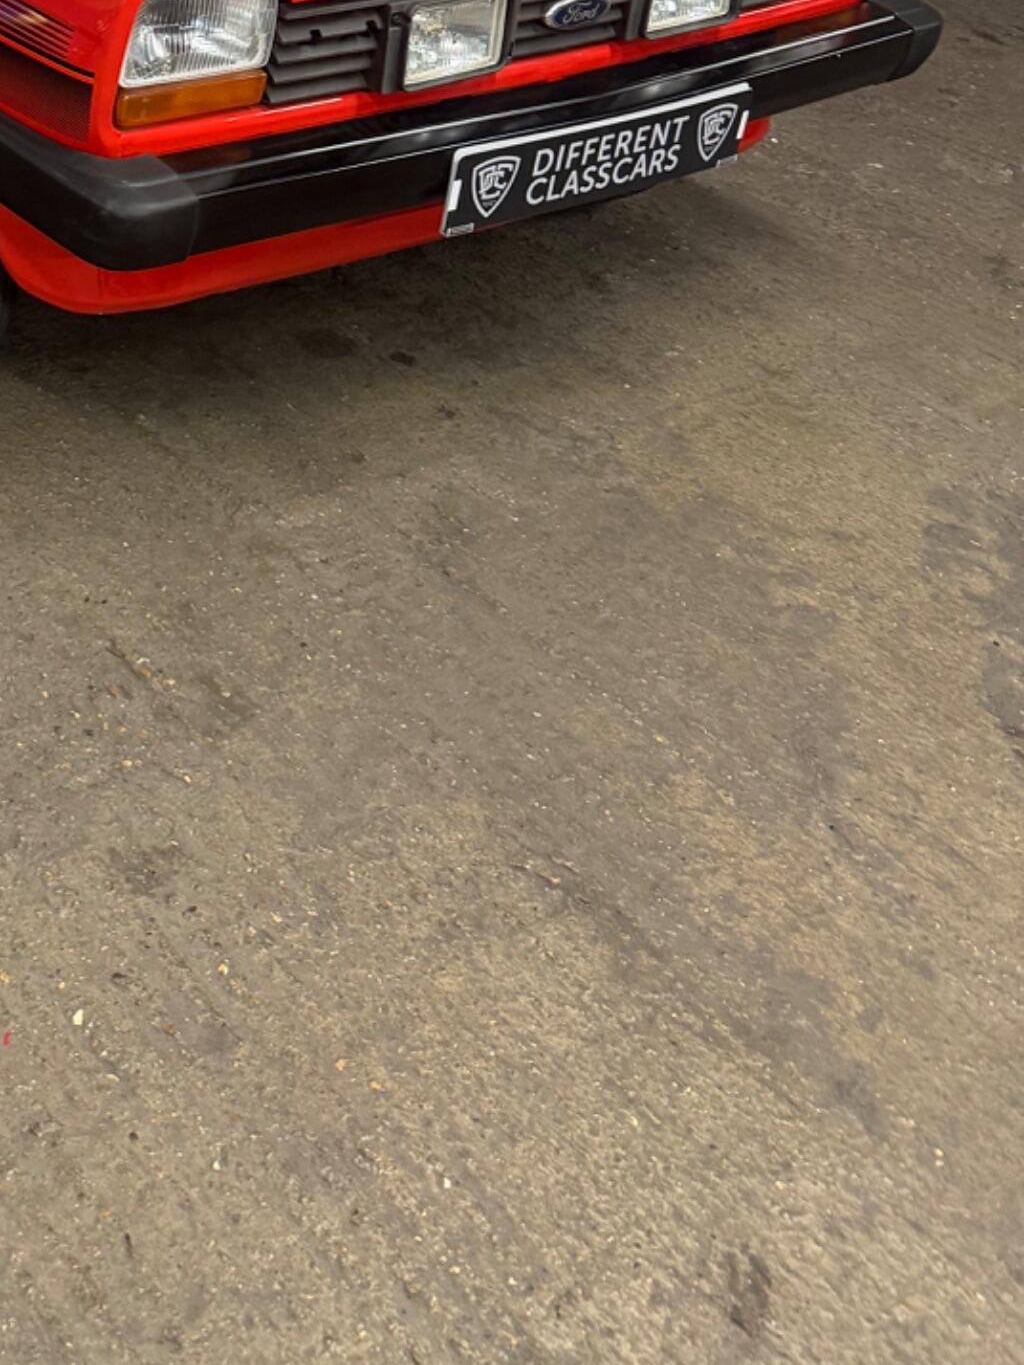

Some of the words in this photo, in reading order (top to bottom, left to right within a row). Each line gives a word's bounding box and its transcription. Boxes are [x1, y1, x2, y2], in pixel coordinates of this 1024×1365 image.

[562, 0, 601, 25] Ford
[526, 144, 681, 205] CLASSCARS
[532, 115, 691, 177] DIFFERENT
